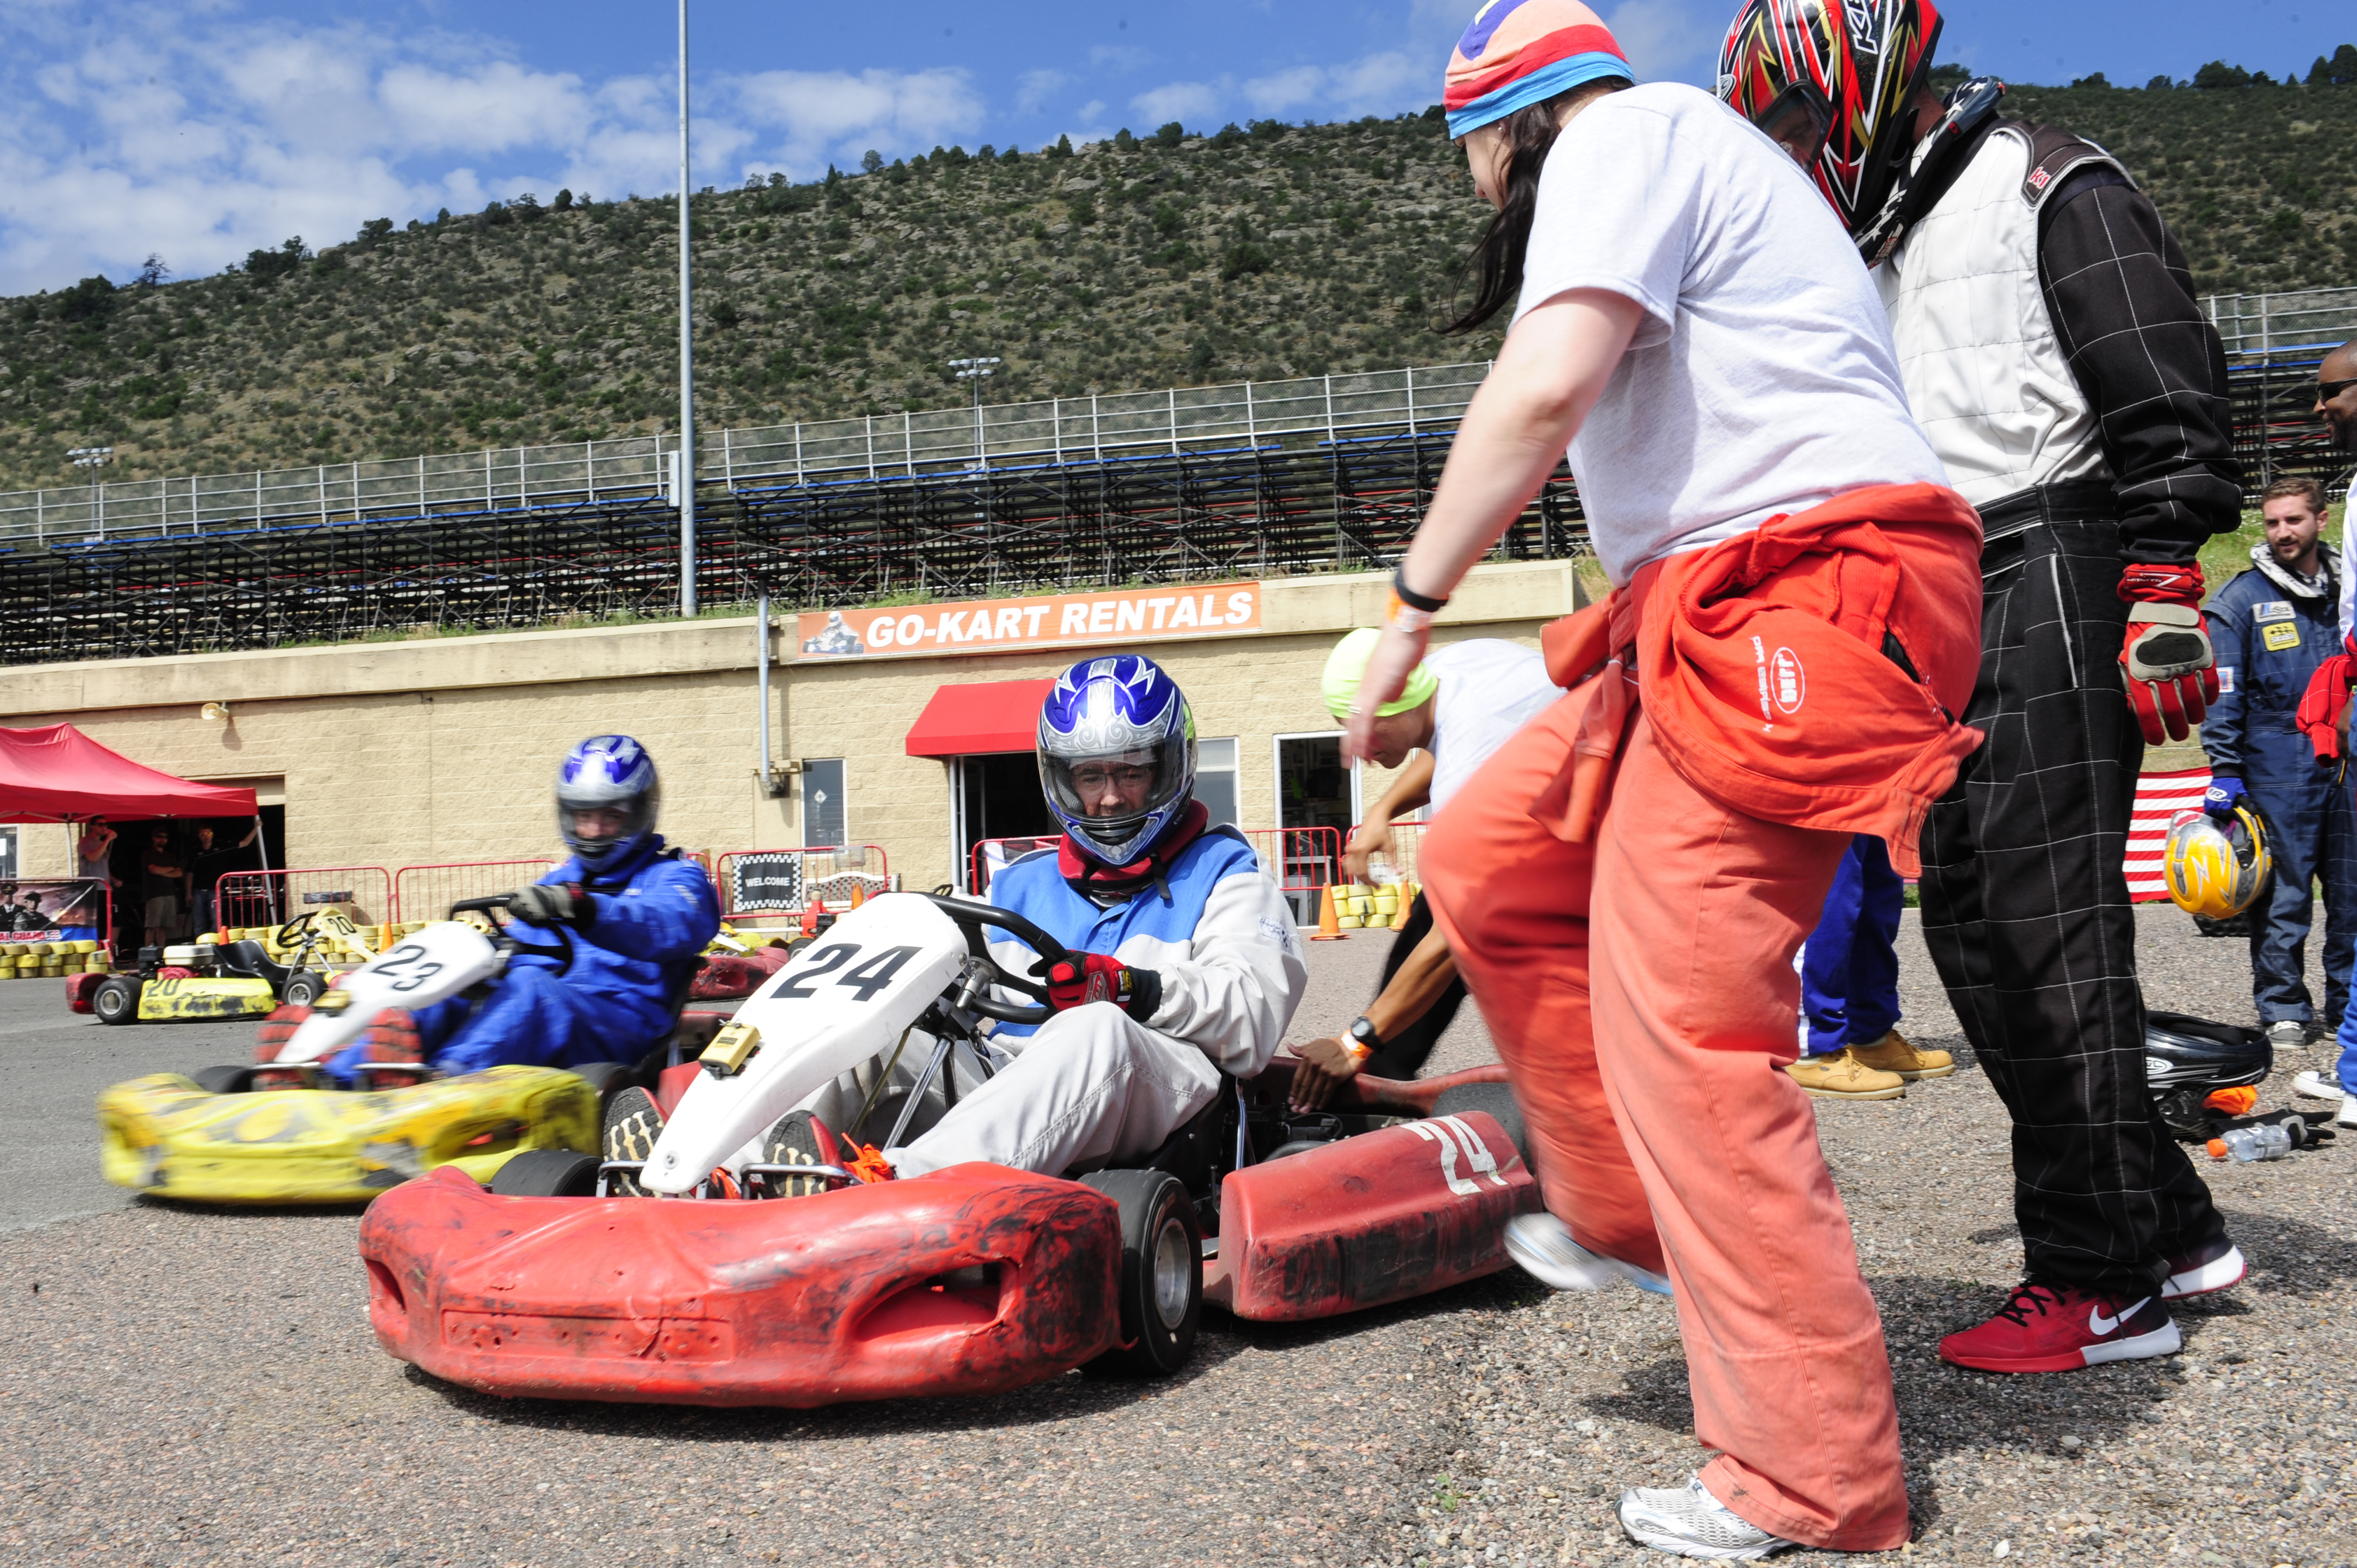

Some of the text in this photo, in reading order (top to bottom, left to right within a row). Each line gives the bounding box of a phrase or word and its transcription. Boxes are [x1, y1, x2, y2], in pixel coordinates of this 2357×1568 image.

[2028, 166, 2051, 189] K1
[866, 591, 1253, 647] GO-KART RENTALS
[745, 877, 790, 887] WELCOME
[13, 931, 46, 941] GUARD
[327, 916, 357, 935] 20
[371, 945, 443, 991] 23
[768, 943, 924, 1002] 24
[1399, 1115, 1509, 1196] 24
